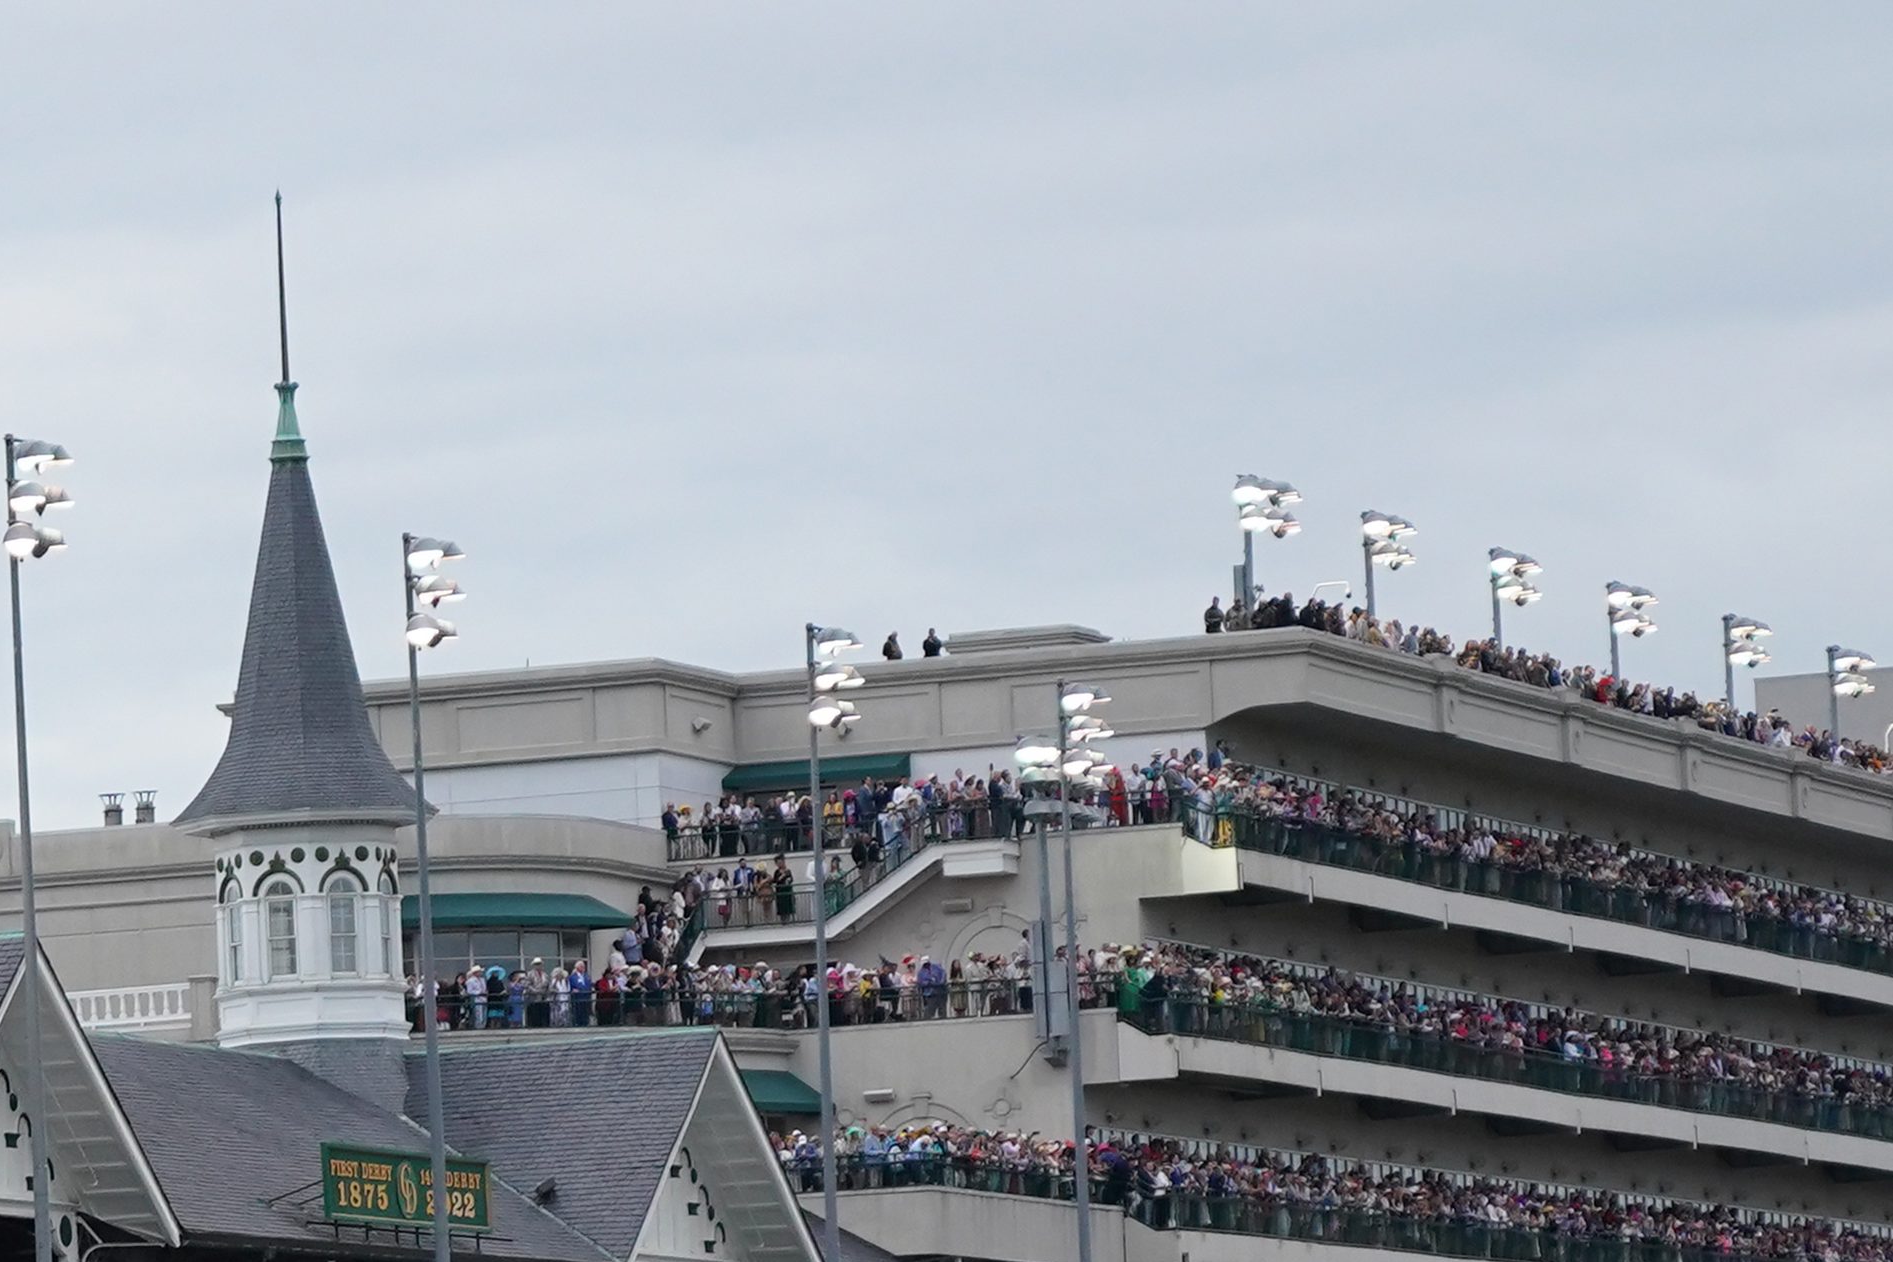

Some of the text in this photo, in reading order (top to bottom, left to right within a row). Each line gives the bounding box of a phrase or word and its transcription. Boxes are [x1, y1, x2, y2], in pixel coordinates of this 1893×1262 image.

[330, 1159, 393, 1182] FIRST DERBY
[337, 1181, 389, 1211] 1875
